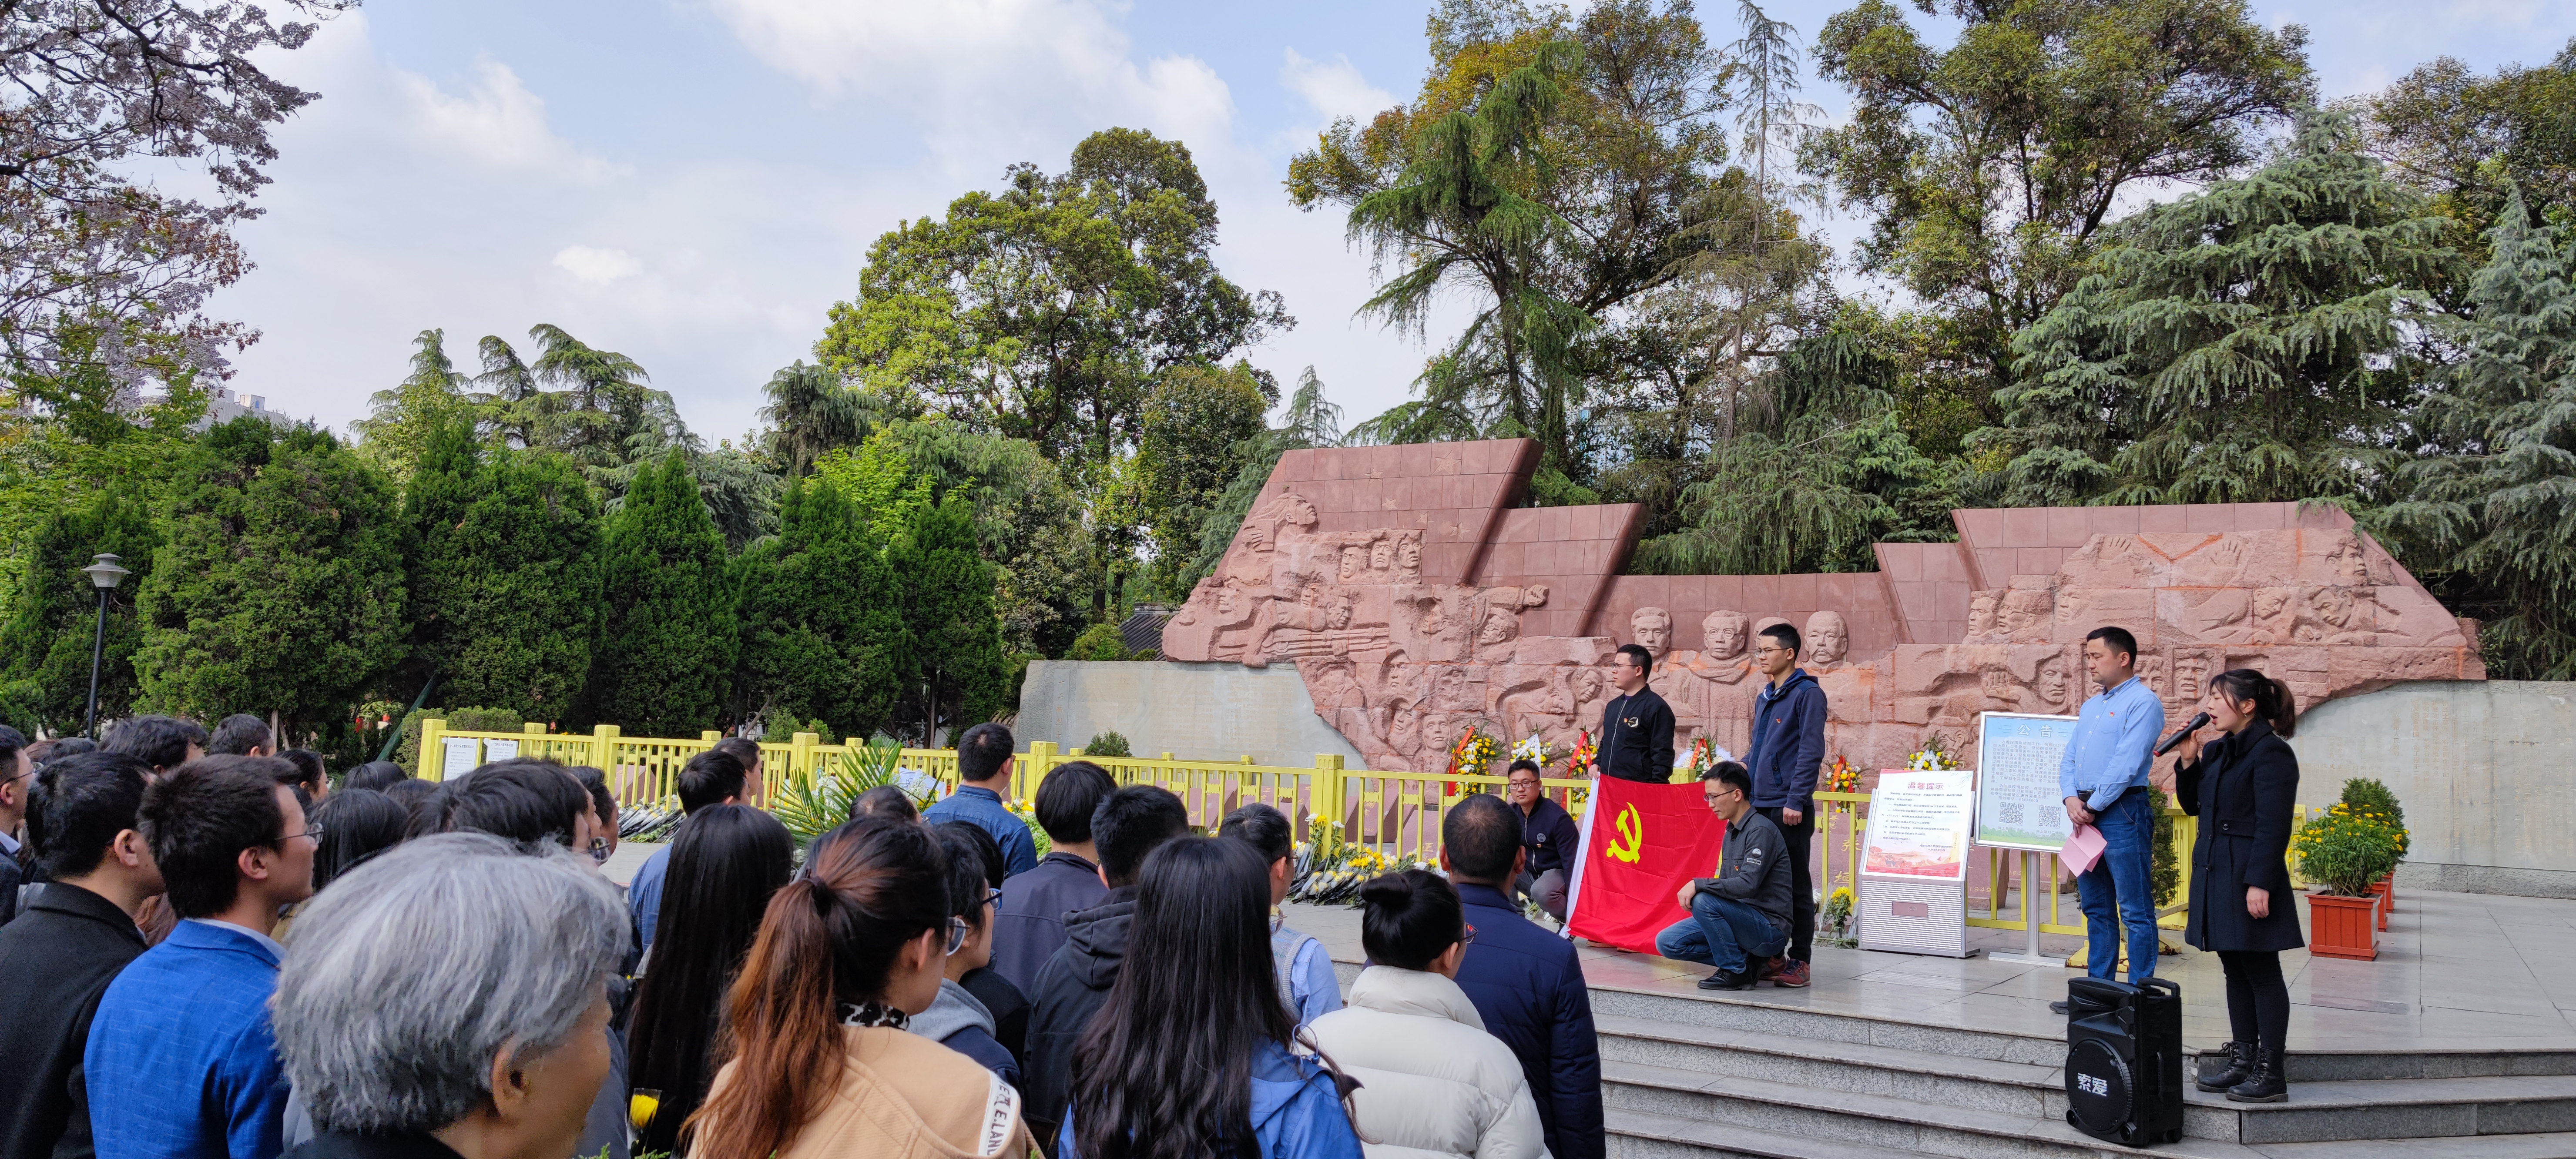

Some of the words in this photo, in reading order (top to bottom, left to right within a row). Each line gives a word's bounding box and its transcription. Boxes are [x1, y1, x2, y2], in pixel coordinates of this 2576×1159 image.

[2017, 724, 2053, 738] 公告
[1908, 781, 1944, 790] 温馨提示
[2077, 1072, 2107, 1097] 索爱
